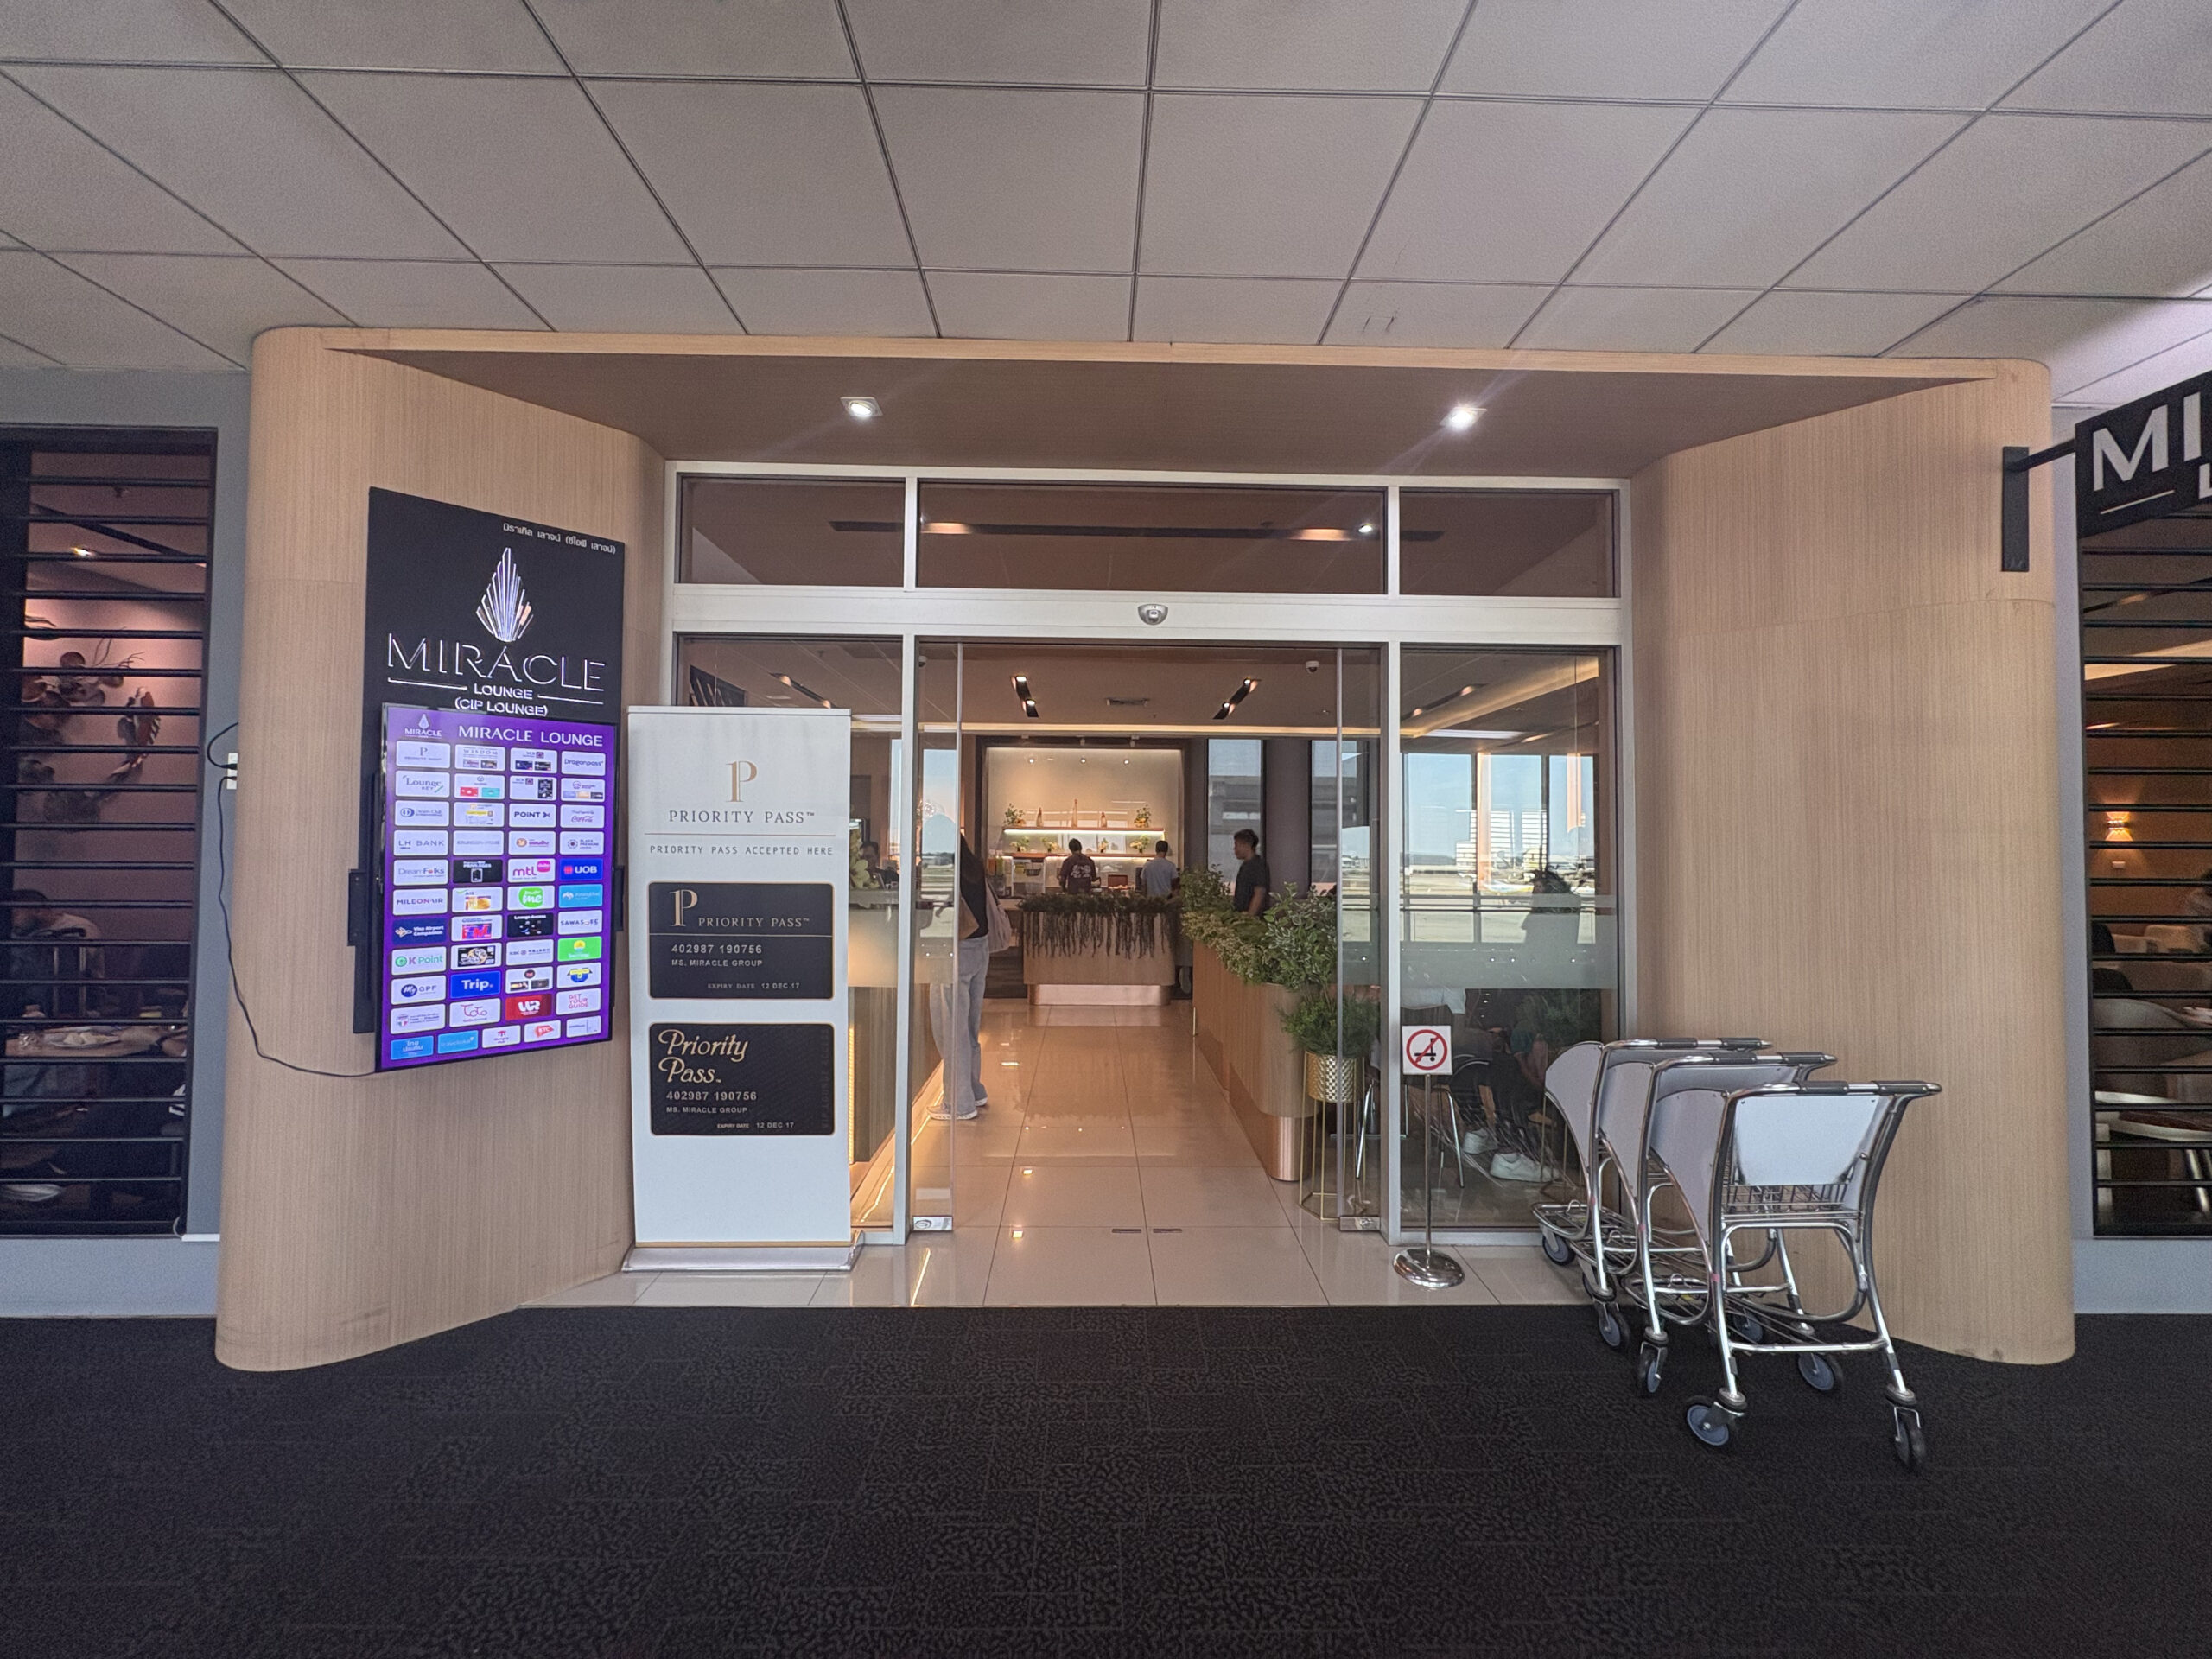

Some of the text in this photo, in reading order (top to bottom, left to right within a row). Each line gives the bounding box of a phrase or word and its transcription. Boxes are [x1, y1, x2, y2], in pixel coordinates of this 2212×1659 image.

[388, 632, 605, 691] MIRACLE
[474, 683, 533, 700] LOUNGE
[454, 696, 548, 717] (CIP LOUNGE)
[404, 728, 442, 737] MIRACLE
[459, 725, 603, 747] MIRACLE LOUNGE
[406, 778, 442, 787] Lounge
[726, 760, 758, 802] P
[669, 810, 754, 822] PRIORITY
[650, 845, 703, 854] PRIORITY
[746, 846, 799, 855] ACCEPTED
[807, 847, 833, 855] HERE
[513, 866, 537, 876] mtl
[670, 889, 698, 927] P
[698, 917, 764, 927] PRIORITY
[671, 944, 762, 954] 402987 190756
[418, 955, 443, 964] Point
[658, 1028, 749, 1063] Priority
[666, 1091, 757, 1102] 402987 190756
